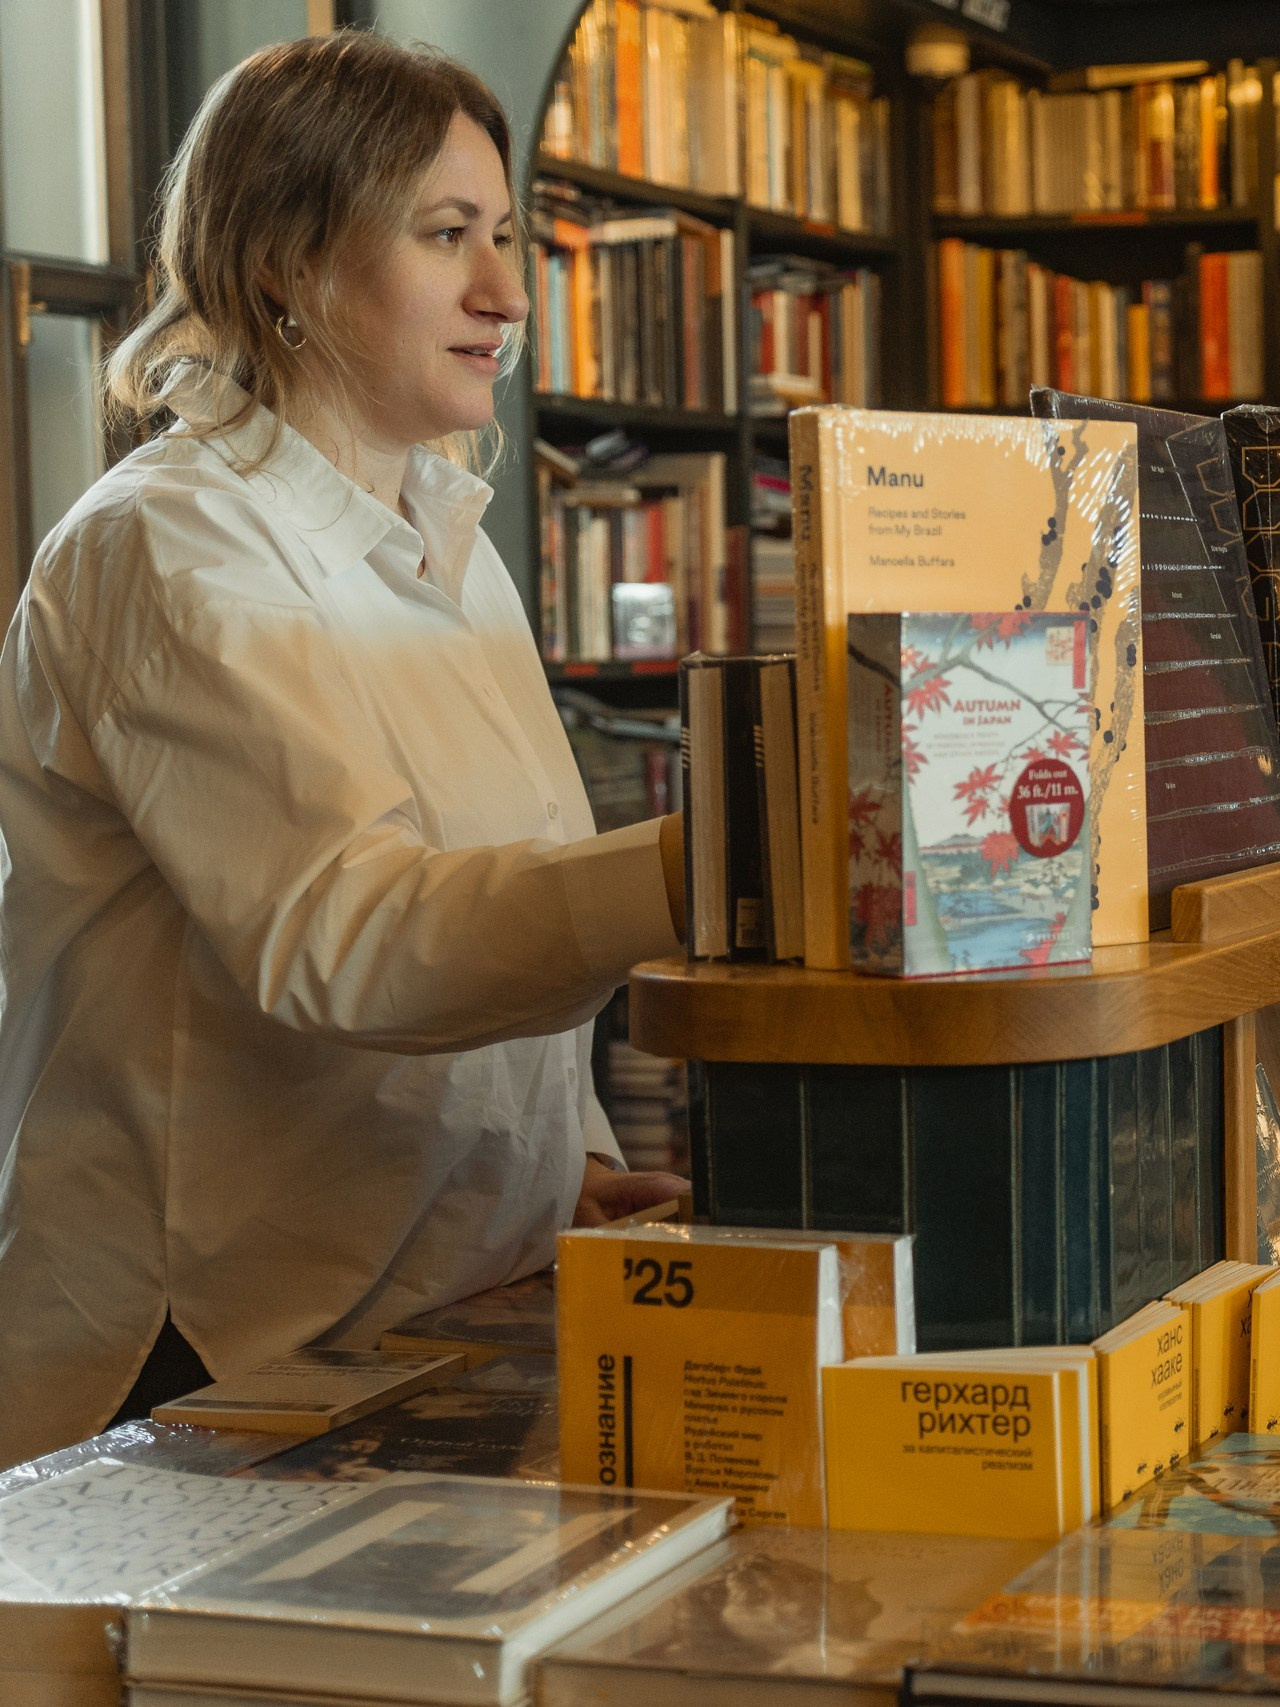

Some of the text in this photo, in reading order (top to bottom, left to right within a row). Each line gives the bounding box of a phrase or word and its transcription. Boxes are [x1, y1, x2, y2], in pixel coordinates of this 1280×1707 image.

[867, 465, 924, 488] Manu
[800, 465, 812, 541] Manu
[868, 507, 966, 522] Recipes and Stories
[869, 524, 943, 538] from My Brazil
[953, 699, 1021, 713] AUTUMN
[963, 715, 1012, 725] IN JAPAN
[1017, 784, 1031, 799] 36
[1063, 785, 1079, 797] m.
[1156, 1324, 1183, 1357] ханс
[1151, 1352, 1183, 1390] хааке
[901, 1380, 1031, 1412] герхард
[597, 1353, 617, 1487] ознание
[918, 1411, 1032, 1442] рихтер
[981, 1459, 1033, 1472] реализм
